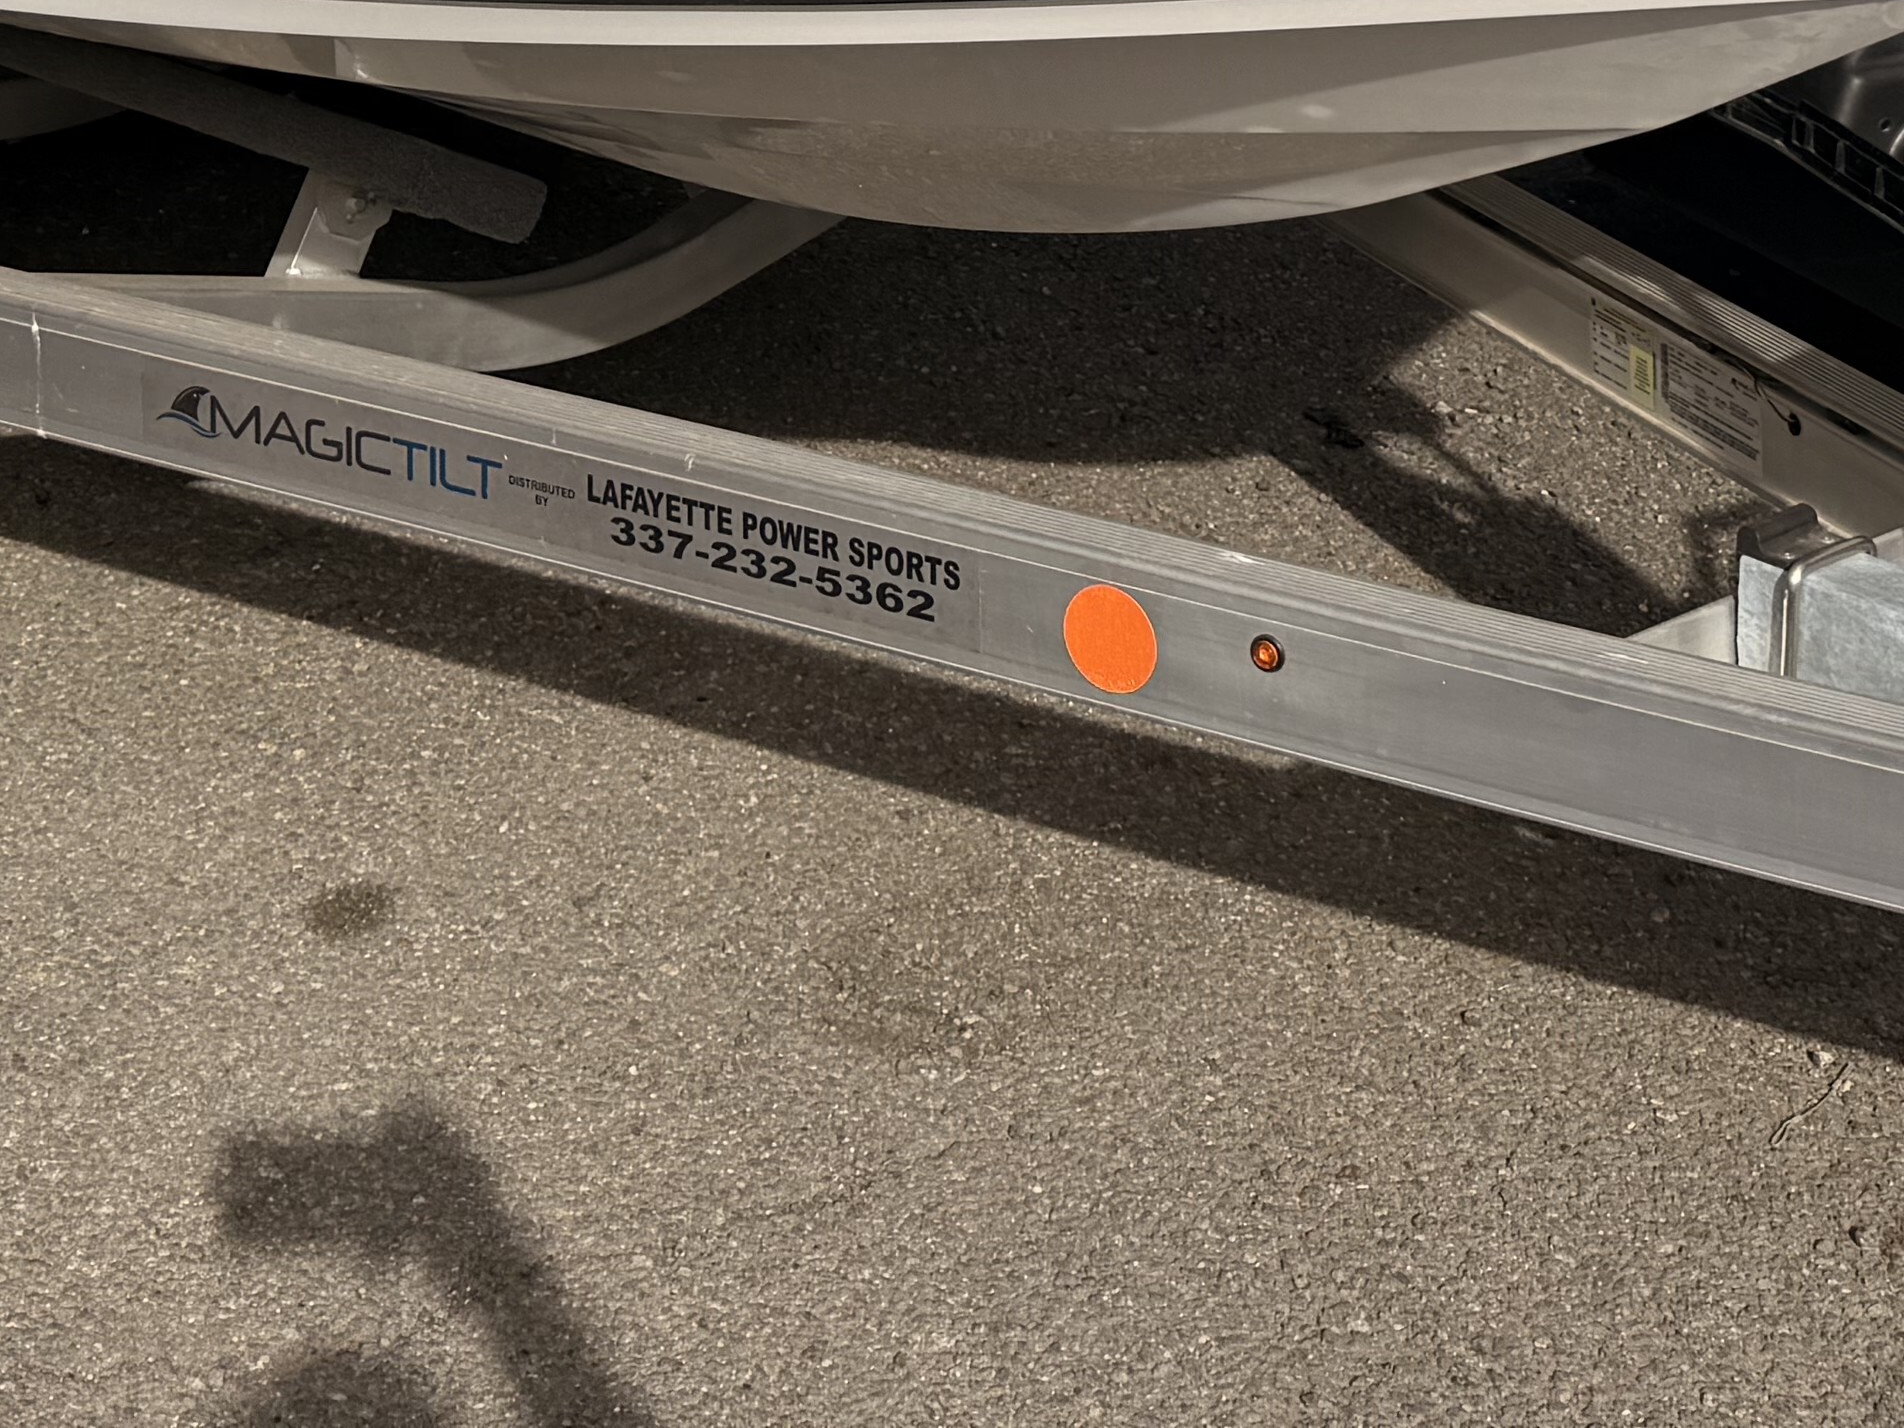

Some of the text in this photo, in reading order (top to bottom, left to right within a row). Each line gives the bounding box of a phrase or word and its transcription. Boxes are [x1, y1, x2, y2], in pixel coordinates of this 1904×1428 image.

[209, 395, 502, 500] MAGICTILT
[508, 474, 575, 500] DISTRIBUTED
[534, 494, 548, 507] BY
[587, 474, 961, 591] LAFAYETTE POWER SPORTS
[610, 517, 936, 623] 337-232-5362
